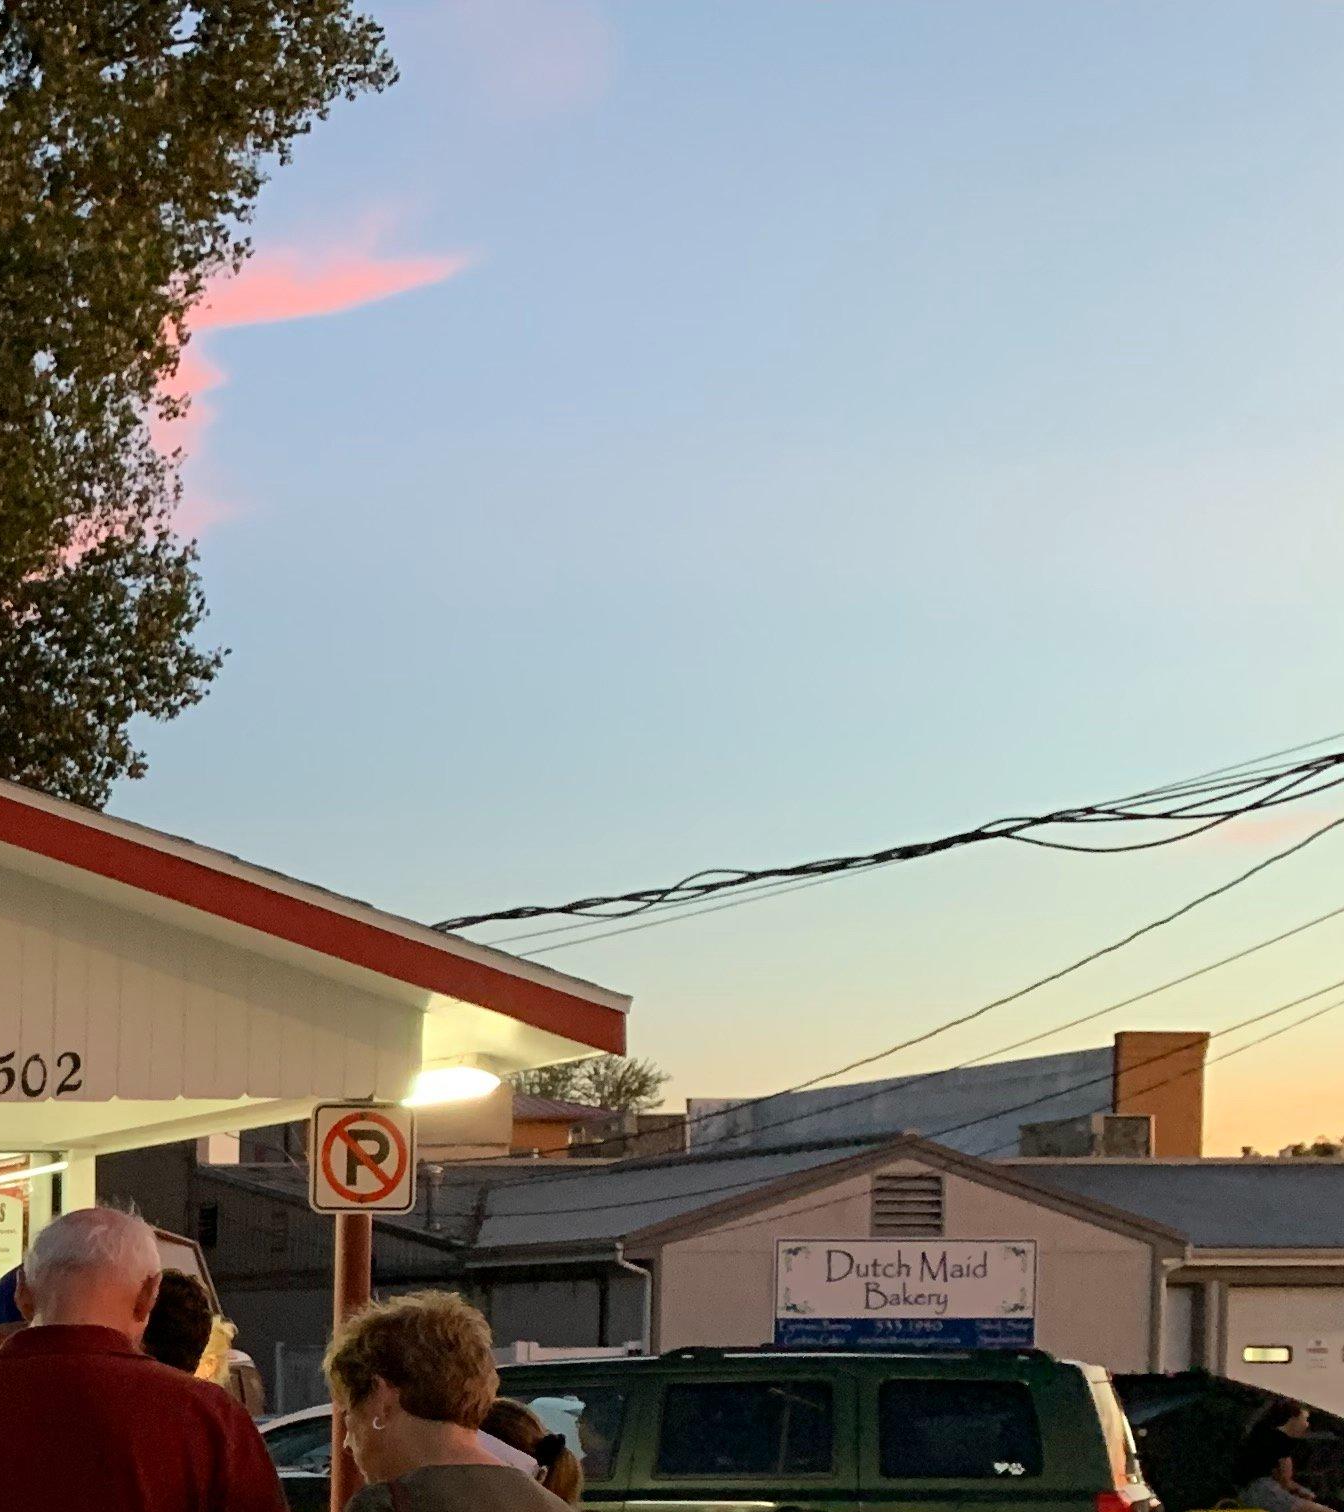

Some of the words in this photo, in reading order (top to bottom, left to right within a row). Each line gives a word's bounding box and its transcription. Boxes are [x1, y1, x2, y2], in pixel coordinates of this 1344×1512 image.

[825, 1249, 912, 1283] Dutch
[920, 1250, 988, 1283] Maid
[864, 1282, 949, 1315] Bakery
